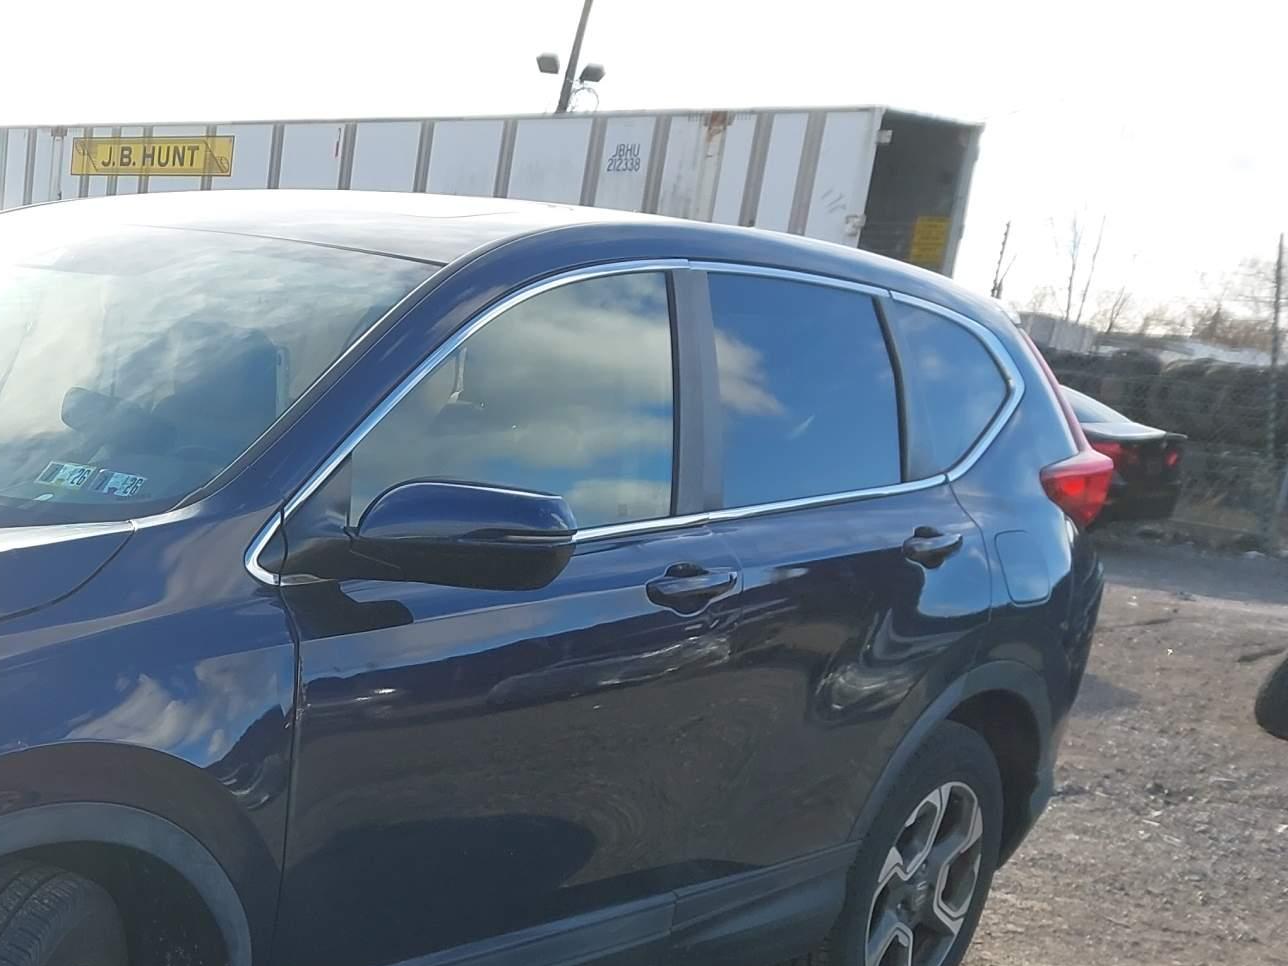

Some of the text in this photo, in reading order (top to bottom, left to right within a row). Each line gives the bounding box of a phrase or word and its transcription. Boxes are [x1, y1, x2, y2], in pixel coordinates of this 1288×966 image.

[101, 145, 200, 168] J.B. HUNT
[611, 143, 641, 158] JBHU
[607, 158, 641, 172] 212338
